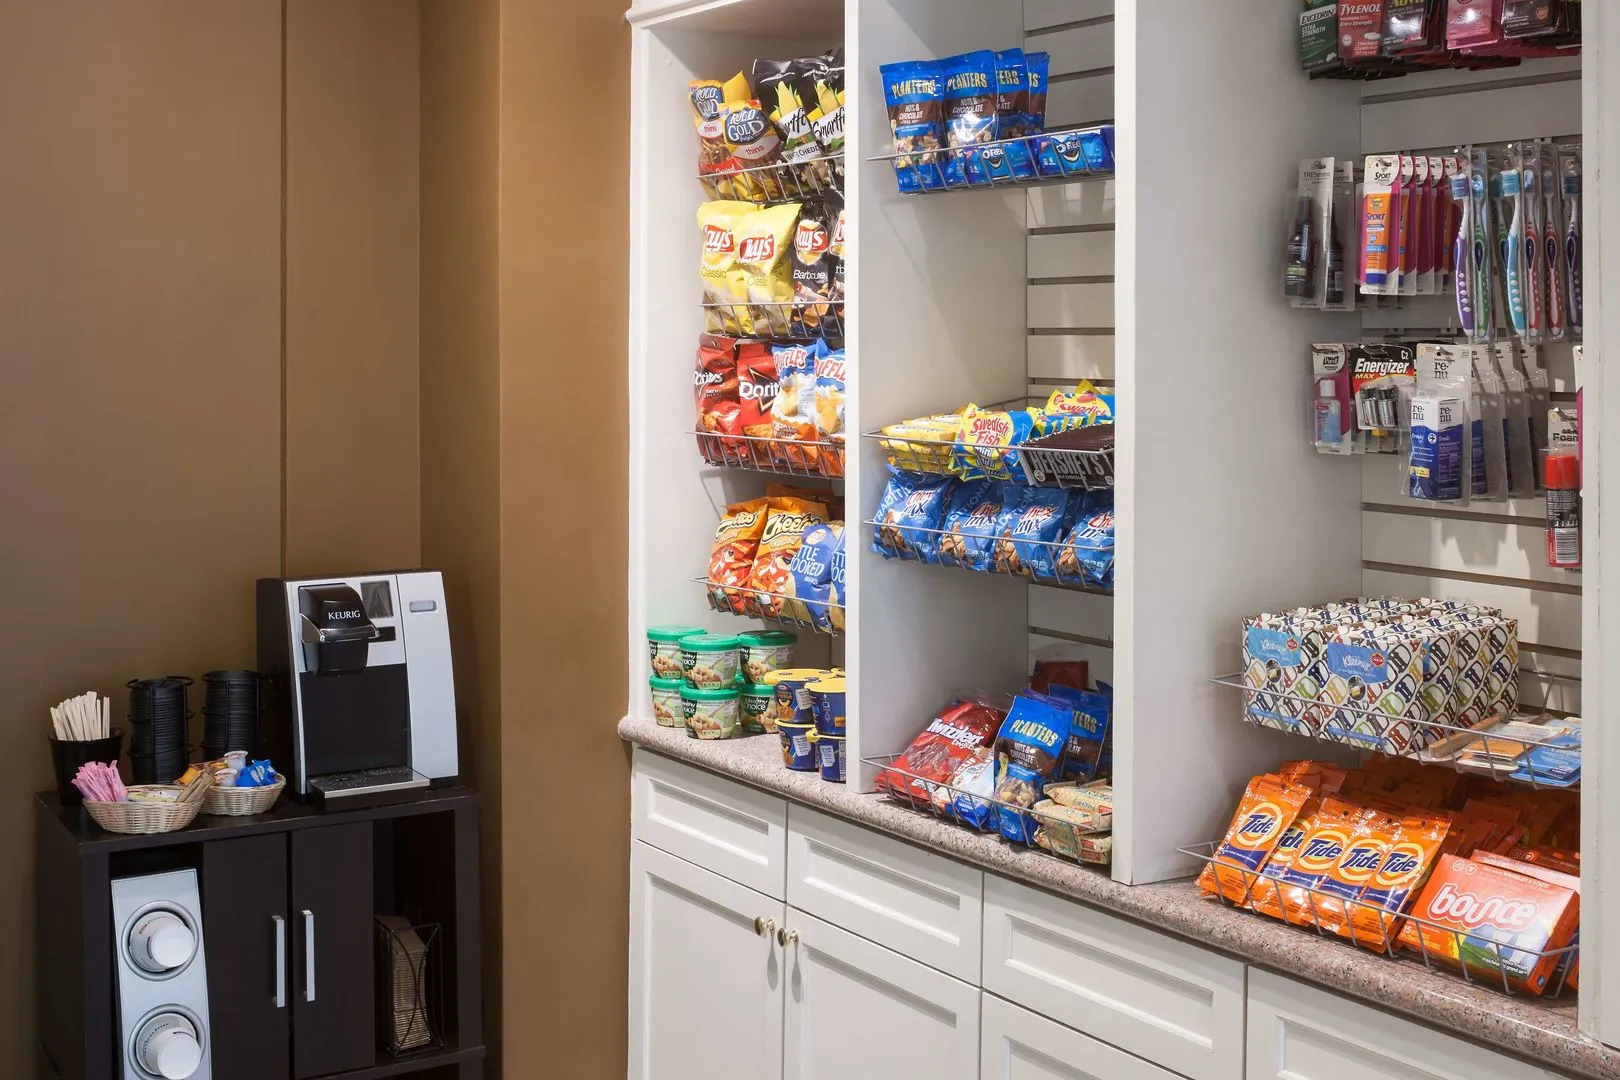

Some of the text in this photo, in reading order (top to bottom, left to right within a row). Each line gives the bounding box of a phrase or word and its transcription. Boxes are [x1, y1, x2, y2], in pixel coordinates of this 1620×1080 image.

[1340, 4, 1381, 16] TYLENOL
[947, 72, 987, 92] PLANTERS
[730, 108, 757, 124] ROLD
[727, 119, 765, 142] GOLD
[745, 144, 765, 156] thins
[1374, 172, 1392, 181] SPORT
[1367, 213, 1386, 221] SPORT
[1355, 358, 1409, 376] Energizer
[1412, 412, 1424, 421] nu
[1440, 413, 1452, 423] nu
[970, 418, 1009, 436] Swedish
[975, 430, 1001, 445] Fish
[1031, 451, 1105, 476] HERSHEY'S
[328, 610, 361, 621] KEURIG
[1343, 655, 1371, 671] Kleenex
[1009, 719, 1059, 747] PLANTERS
[1238, 814, 1274, 834] Tide
[1300, 838, 1343, 859] Tide
[1340, 848, 1381, 869] Tide
[1377, 852, 1417, 875] Tide
[1430, 884, 1536, 928] bounce
